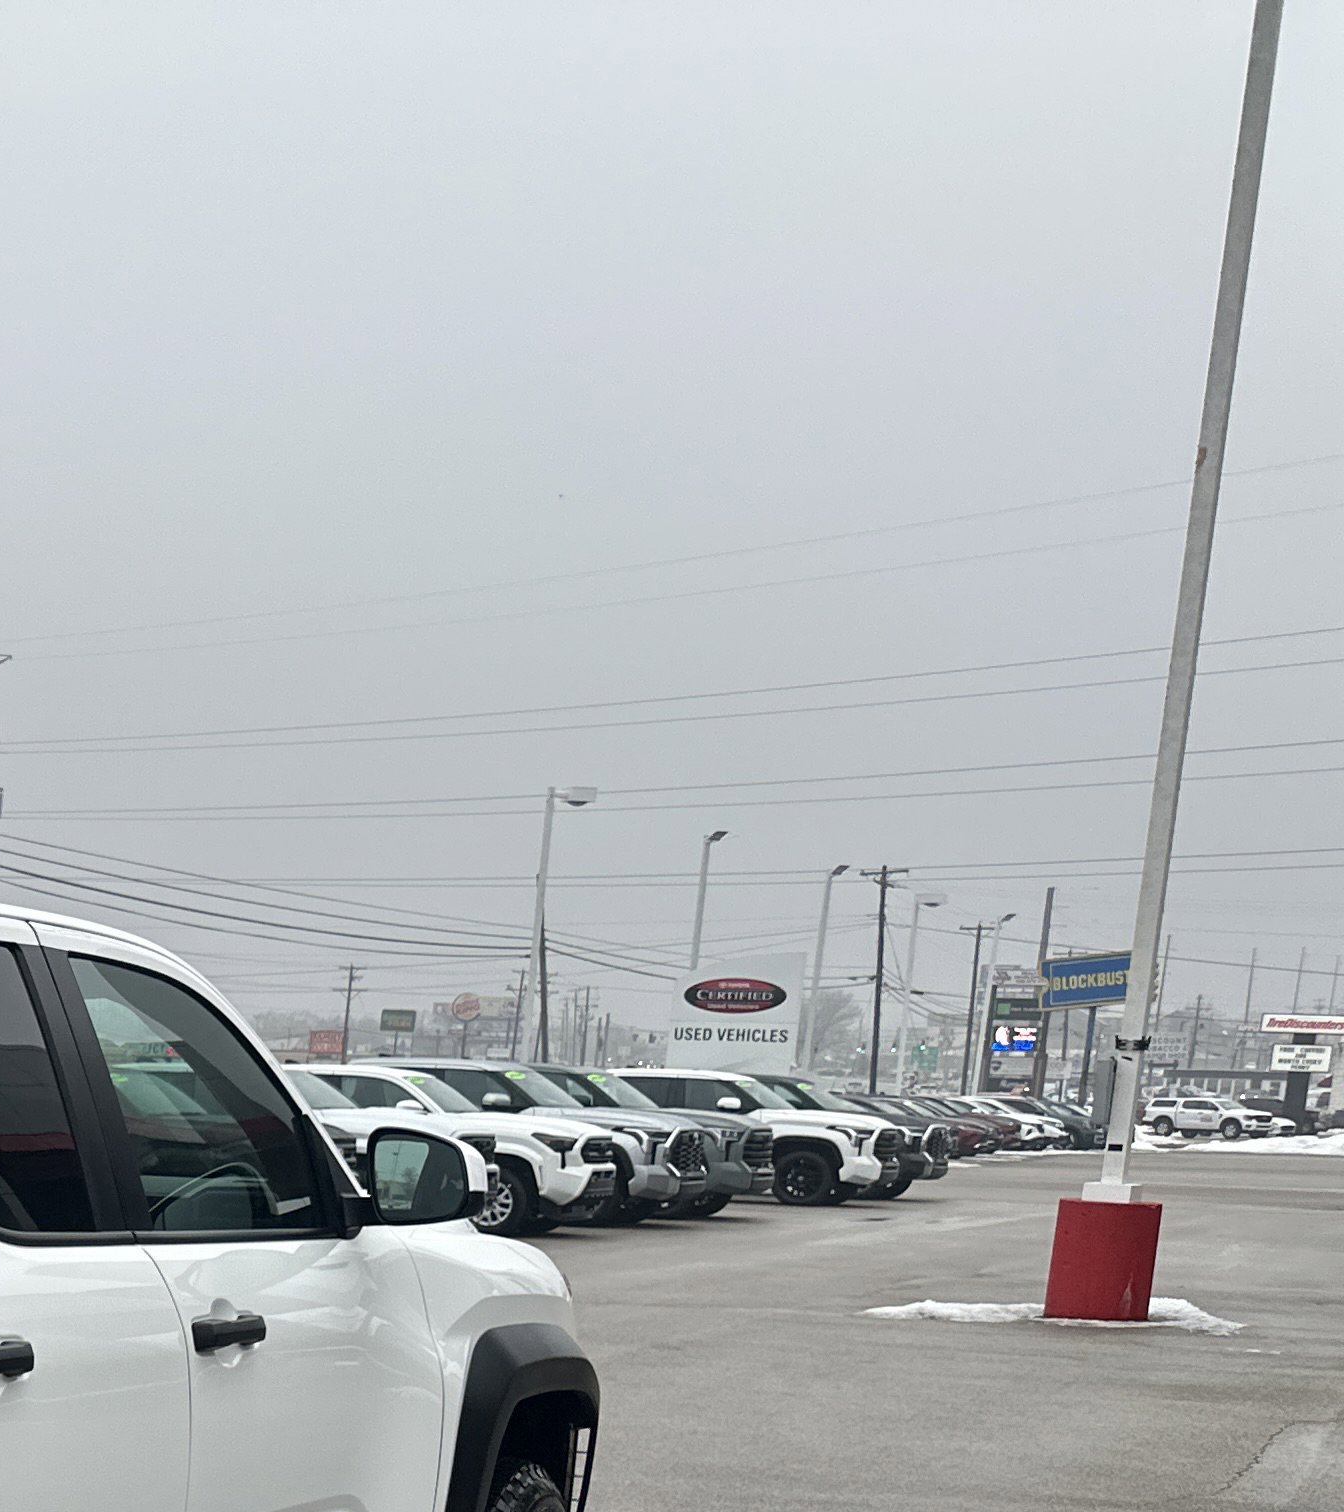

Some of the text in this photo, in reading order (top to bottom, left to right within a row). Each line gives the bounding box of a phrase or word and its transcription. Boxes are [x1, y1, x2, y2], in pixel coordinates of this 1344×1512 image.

[1053, 970, 1130, 991] BLOCKBUST
[696, 989, 774, 1001] CERTIFIED
[674, 1027, 789, 1043] USED VEHICLES
